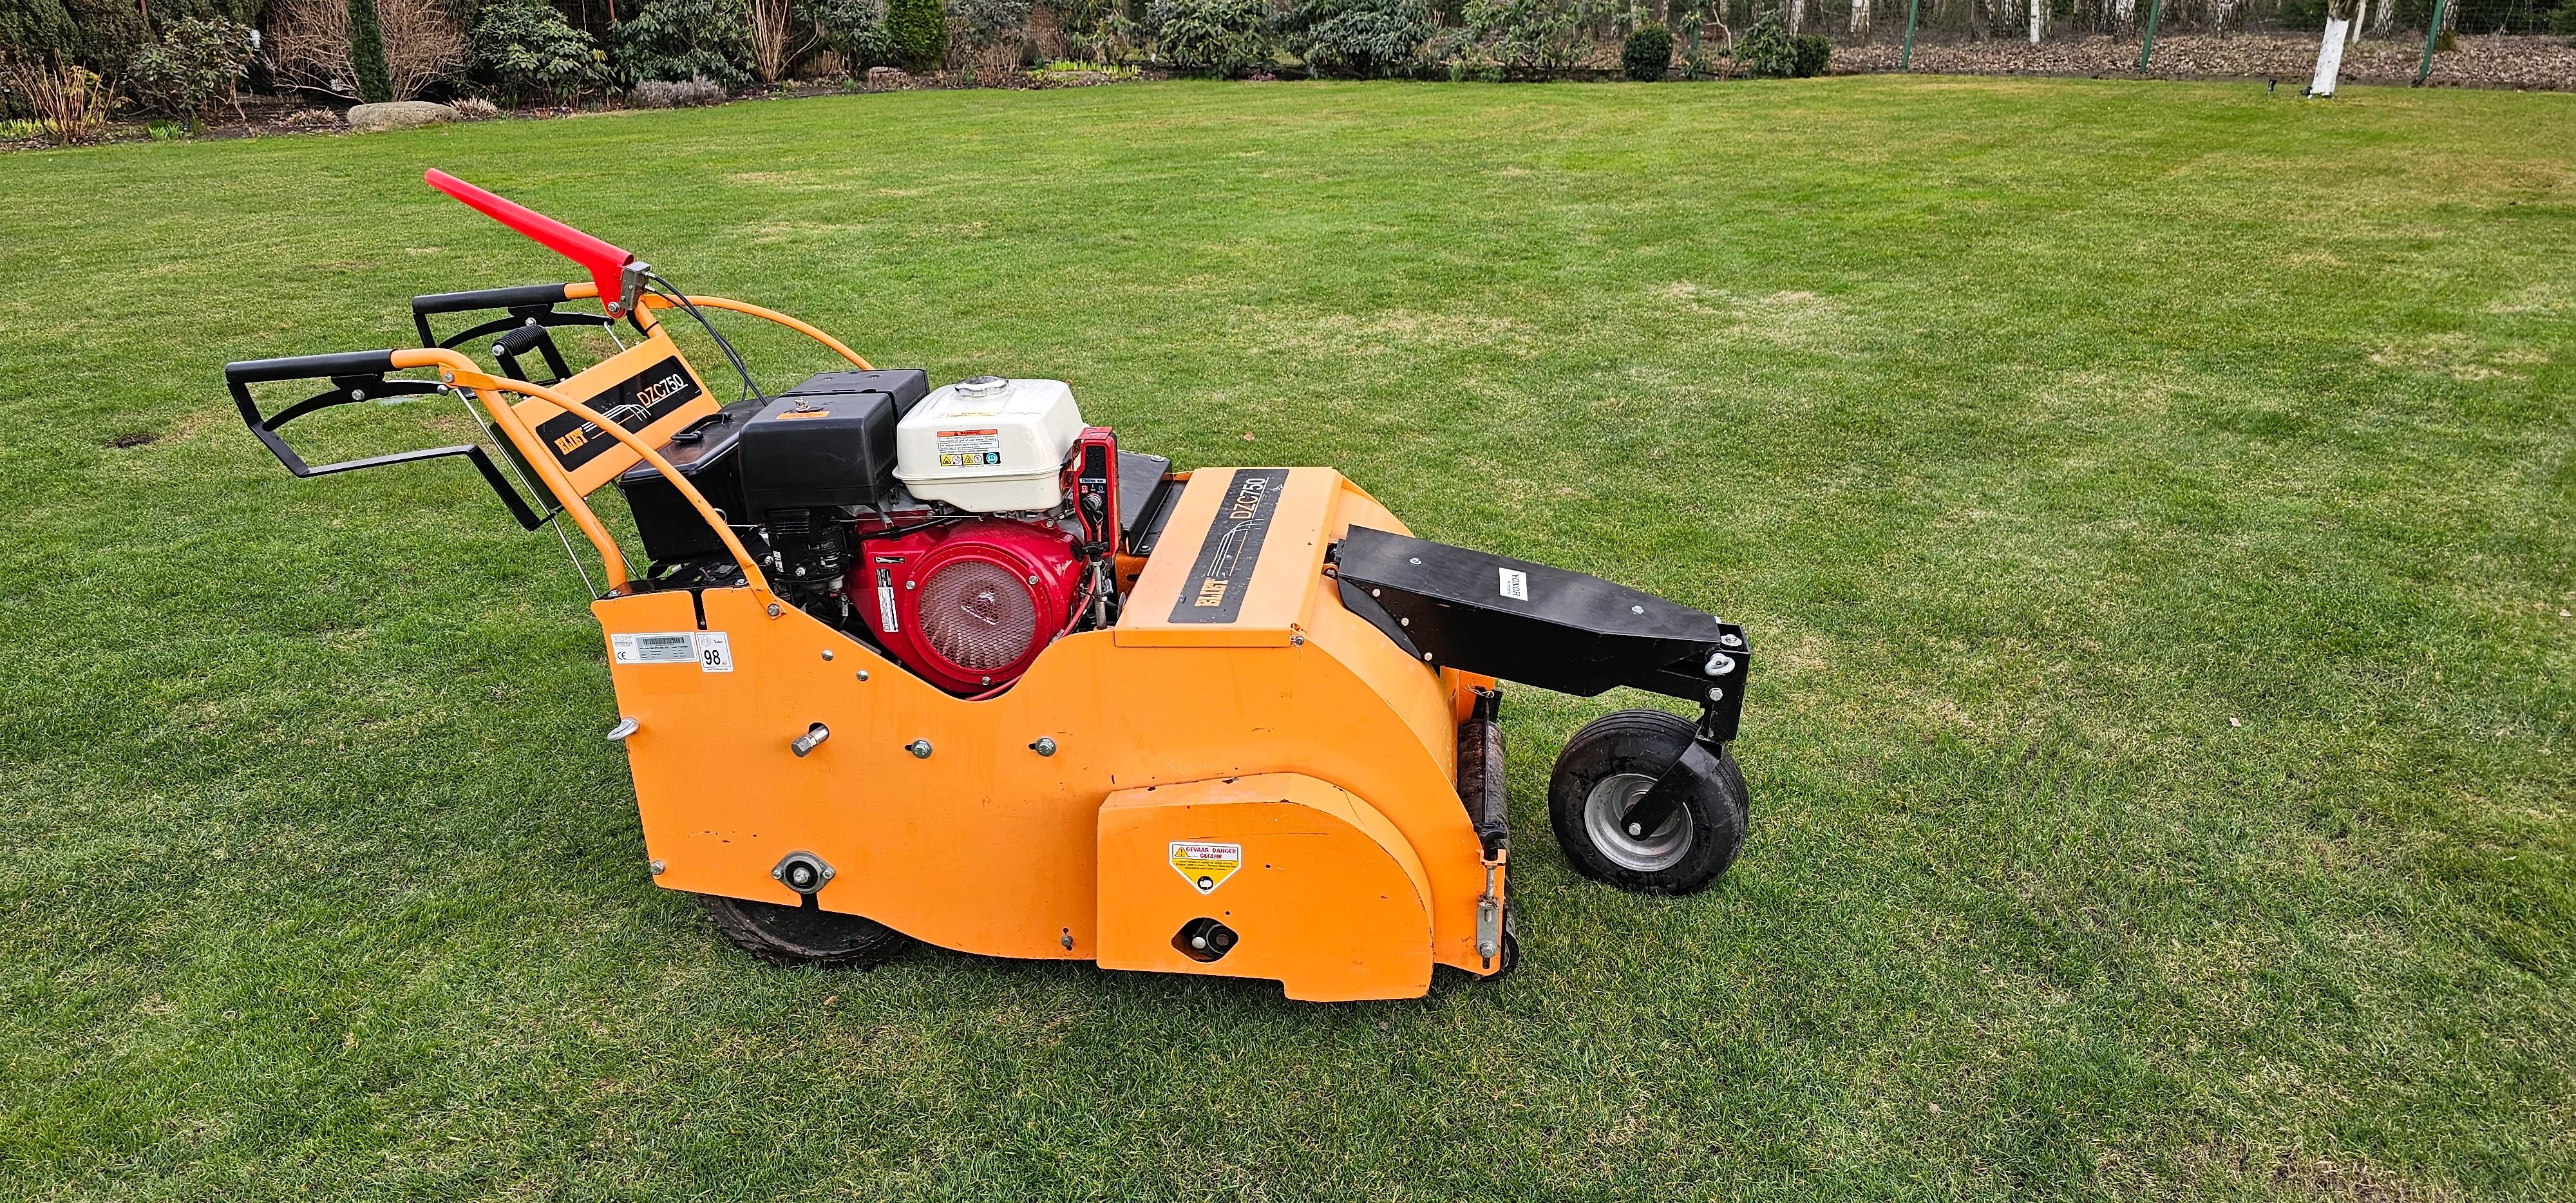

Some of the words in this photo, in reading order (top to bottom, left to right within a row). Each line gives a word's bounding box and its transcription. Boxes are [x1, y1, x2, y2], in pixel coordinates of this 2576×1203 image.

[637, 374, 684, 407] DZC750
[1229, 478, 1267, 519] DZC750
[704, 649, 721, 665] 98
